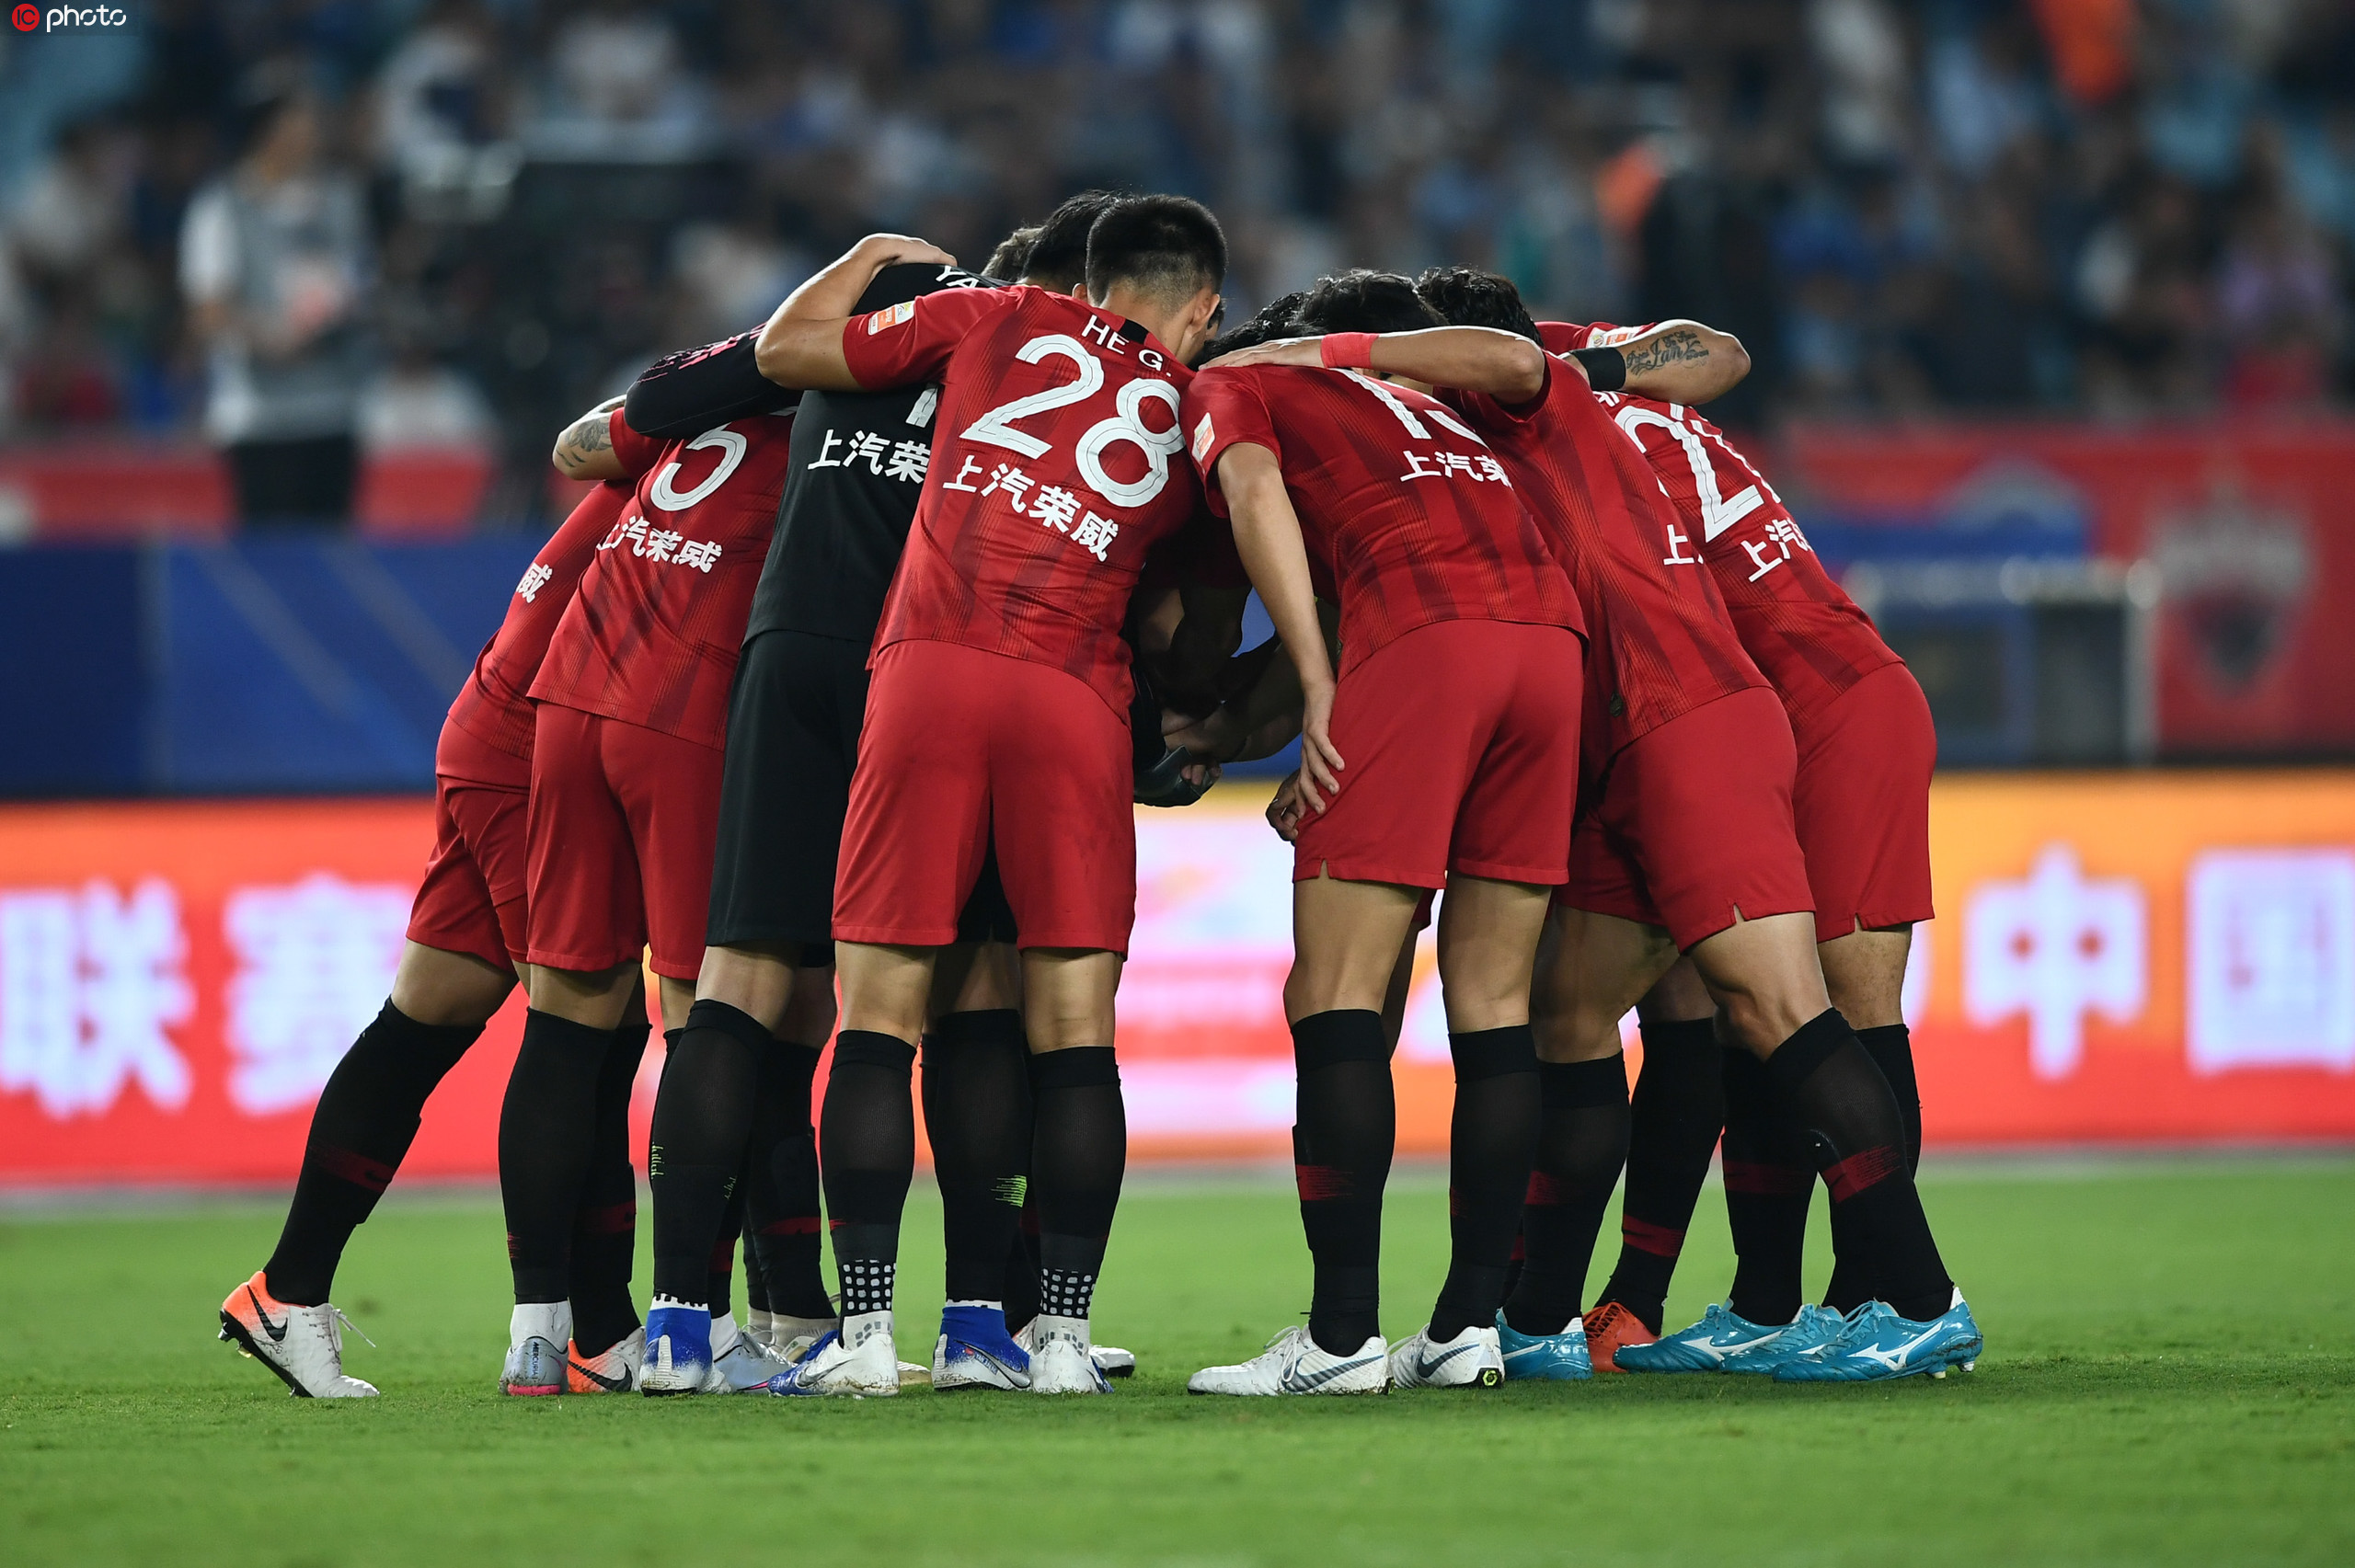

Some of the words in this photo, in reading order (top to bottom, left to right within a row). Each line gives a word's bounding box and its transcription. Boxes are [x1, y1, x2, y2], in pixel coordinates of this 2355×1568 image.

[936, 265, 997, 290] YA
[1081, 314, 1130, 355] HE
[1138, 349, 1172, 378] G.
[959, 334, 1187, 508] 28
[807, 429, 931, 485] 上汽荣
[1614, 402, 1781, 544] 2
[942, 454, 1120, 563] 上汽荣威
[1663, 523, 1704, 566] 上
[1740, 517, 1813, 583] 上汽
[515, 562, 553, 603] 威
[1959, 839, 2355, 1080] 中国
